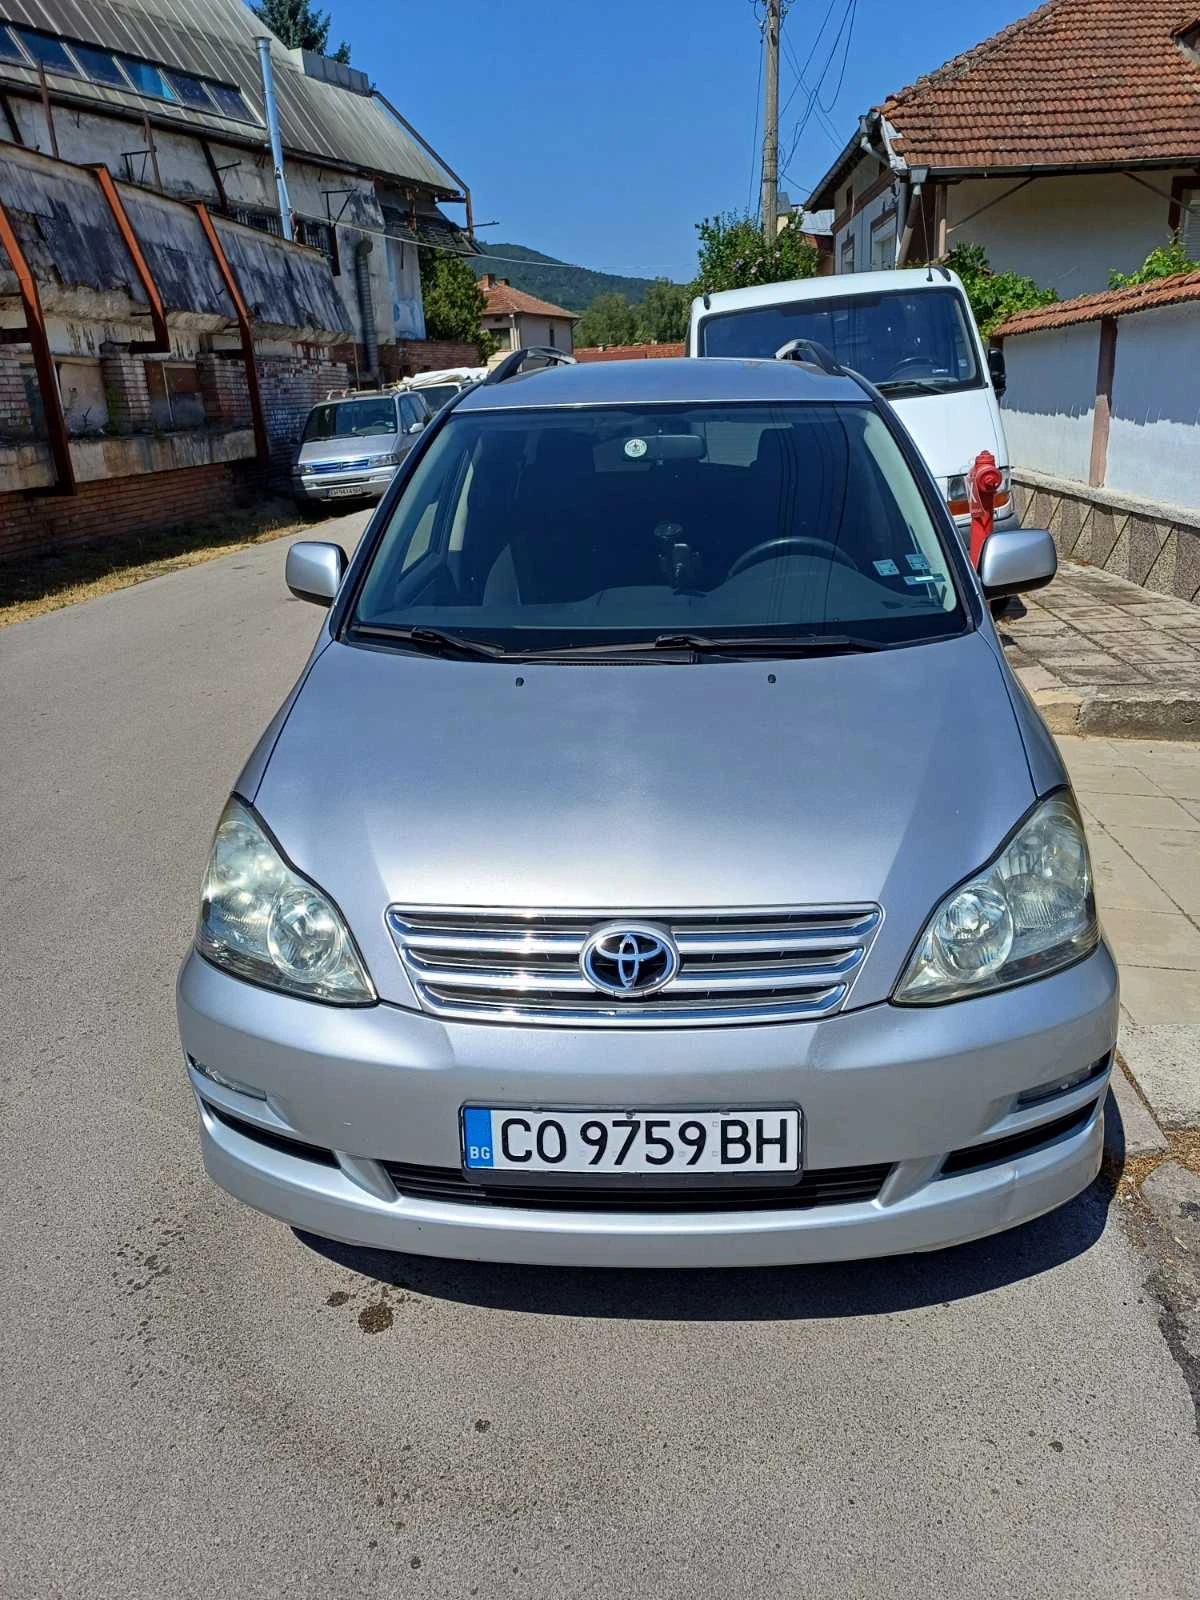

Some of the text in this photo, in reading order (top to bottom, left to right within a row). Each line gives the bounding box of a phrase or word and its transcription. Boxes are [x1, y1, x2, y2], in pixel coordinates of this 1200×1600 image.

[469, 1145, 491, 1160] BG
[501, 1117, 788, 1166] CO 9759 BH
